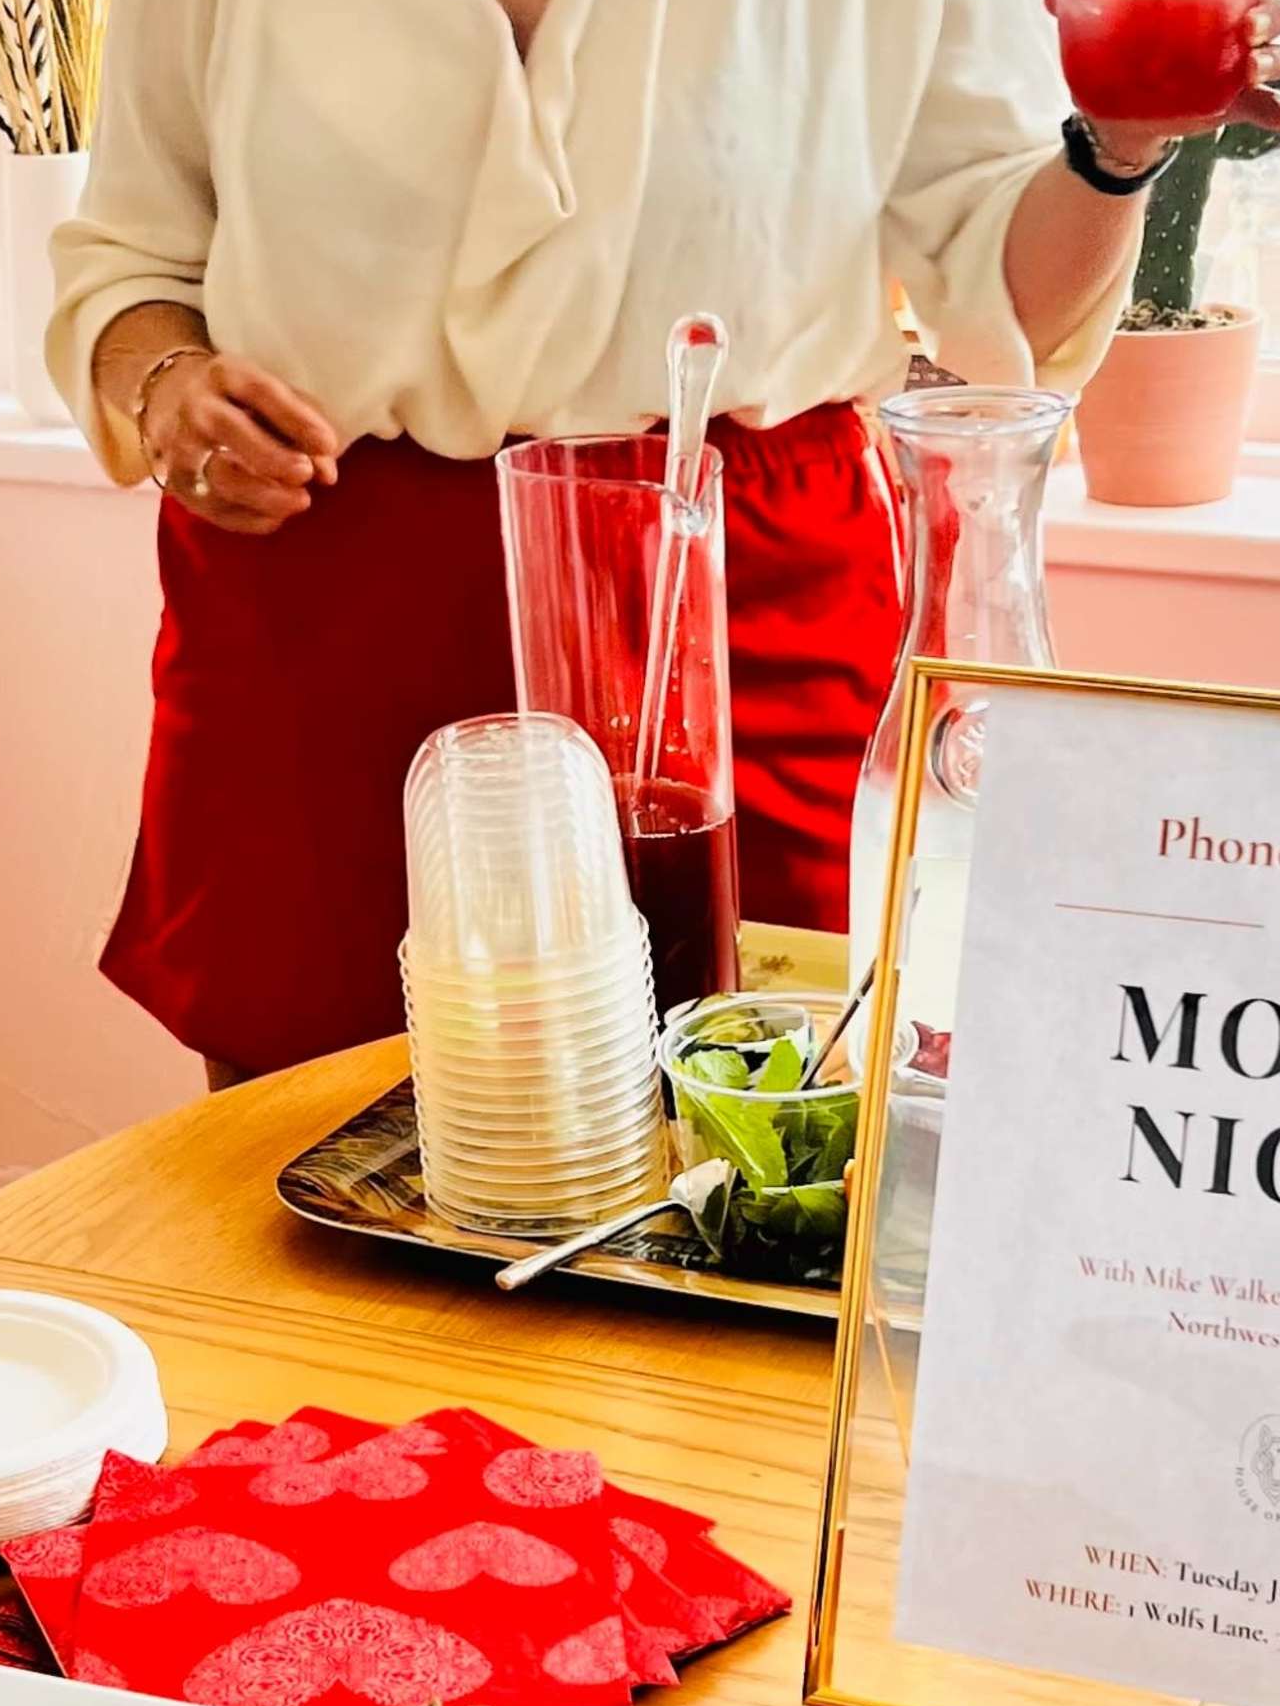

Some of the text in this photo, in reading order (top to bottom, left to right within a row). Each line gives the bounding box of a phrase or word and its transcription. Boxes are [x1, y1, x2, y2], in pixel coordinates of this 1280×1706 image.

[1078, 1255, 1135, 1284] With
[1143, 1266, 1201, 1293] Mike
[1085, 1543, 1168, 1579] WHEN:
[1175, 1561, 1262, 1602] Tuesday
[1026, 1578, 1122, 1614] WHERE:
[1144, 1601, 1205, 1631] Wolfs
